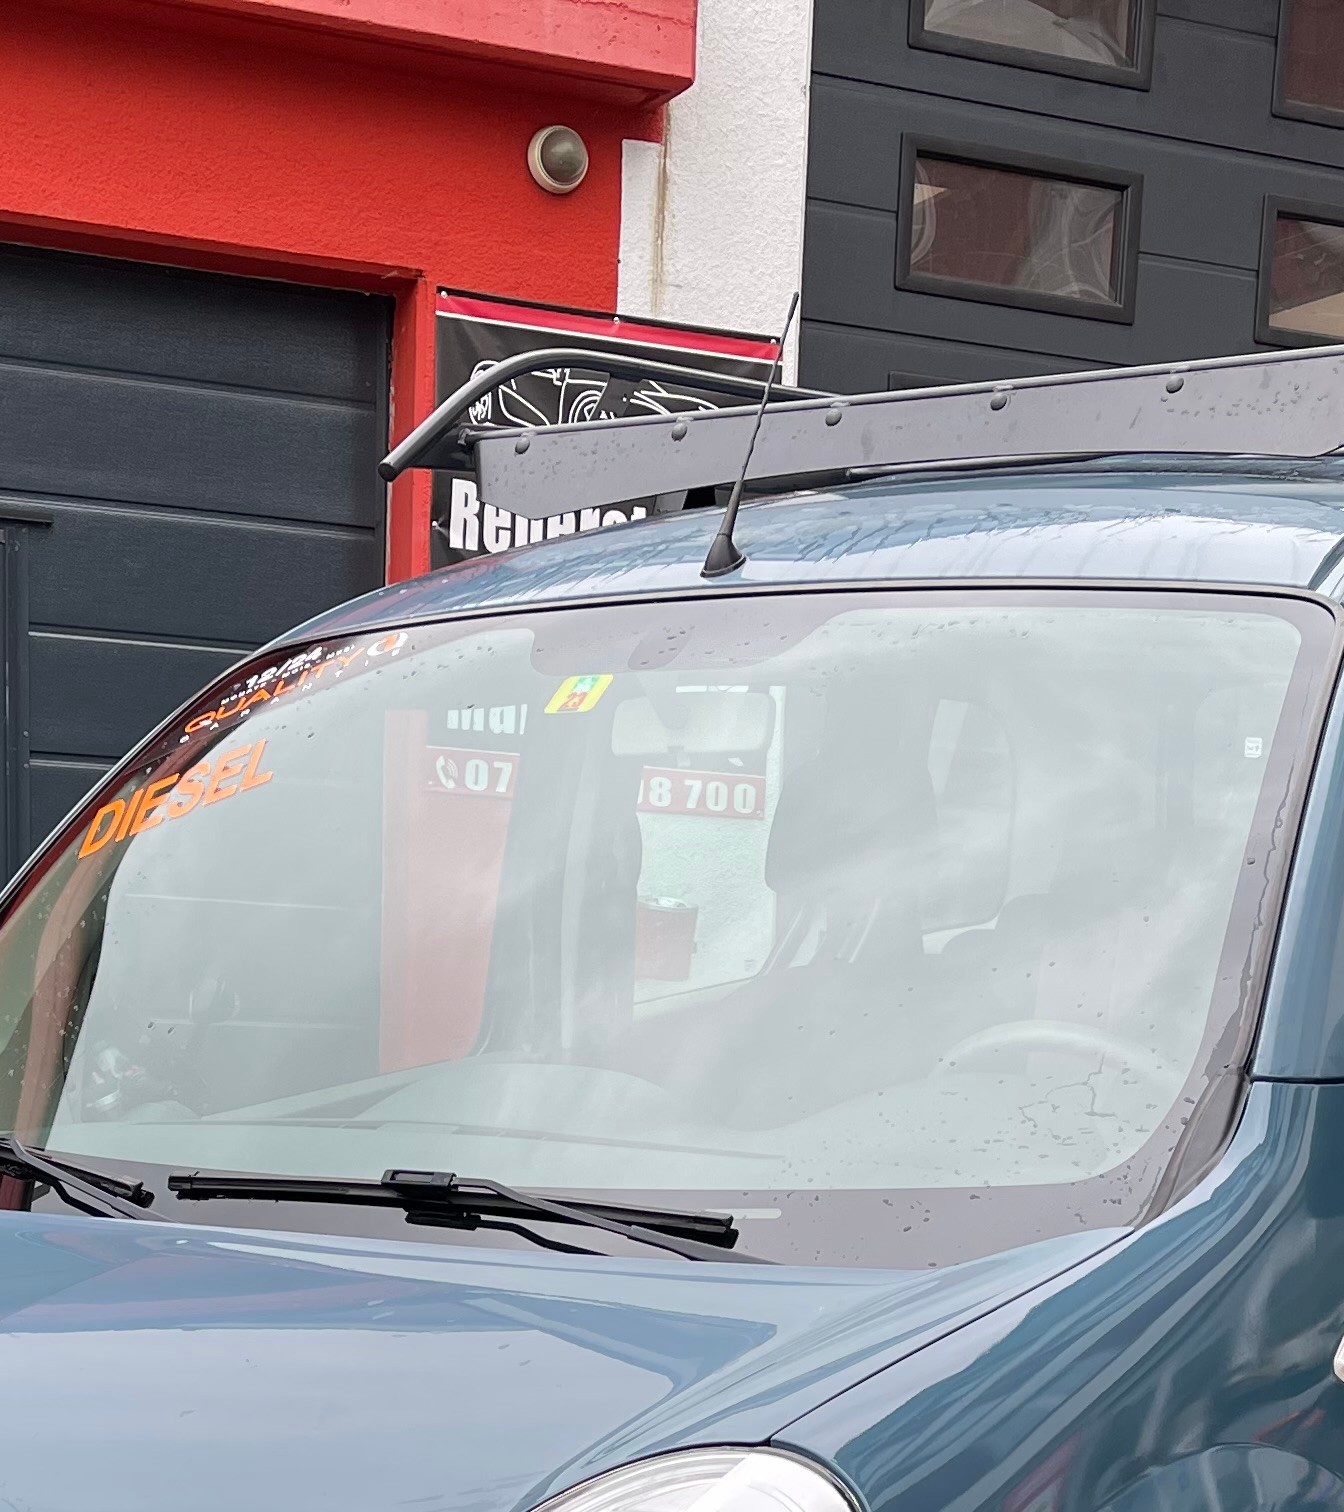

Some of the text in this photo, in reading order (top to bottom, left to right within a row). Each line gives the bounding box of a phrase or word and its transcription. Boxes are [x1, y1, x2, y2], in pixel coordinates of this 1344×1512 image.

[246, 646, 323, 688] 12/24
[77, 738, 274, 860] DIESEL
[638, 775, 673, 808] 8
[684, 779, 757, 815] 700
